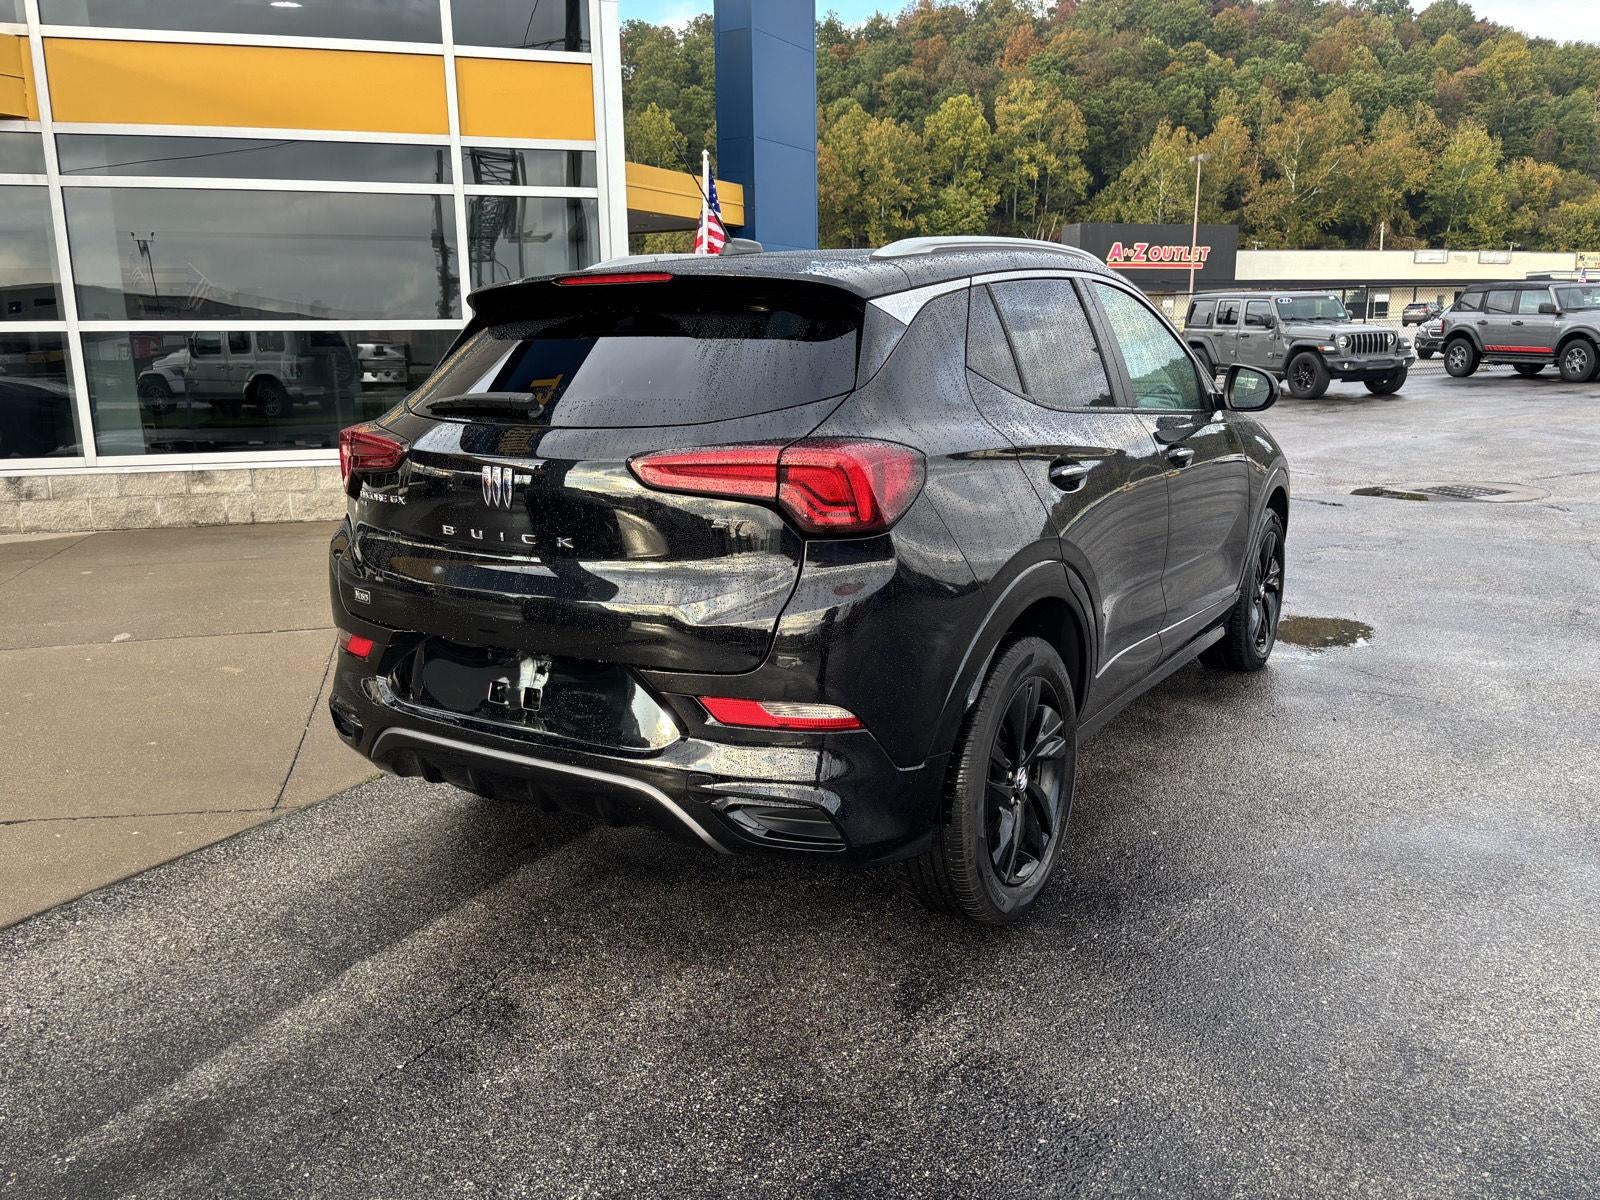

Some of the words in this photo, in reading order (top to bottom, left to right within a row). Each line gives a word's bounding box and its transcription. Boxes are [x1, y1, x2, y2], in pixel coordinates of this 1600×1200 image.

[1149, 246, 1211, 261] OUTLET
[390, 495, 406, 506] GX
[442, 524, 574, 549] BUICK
